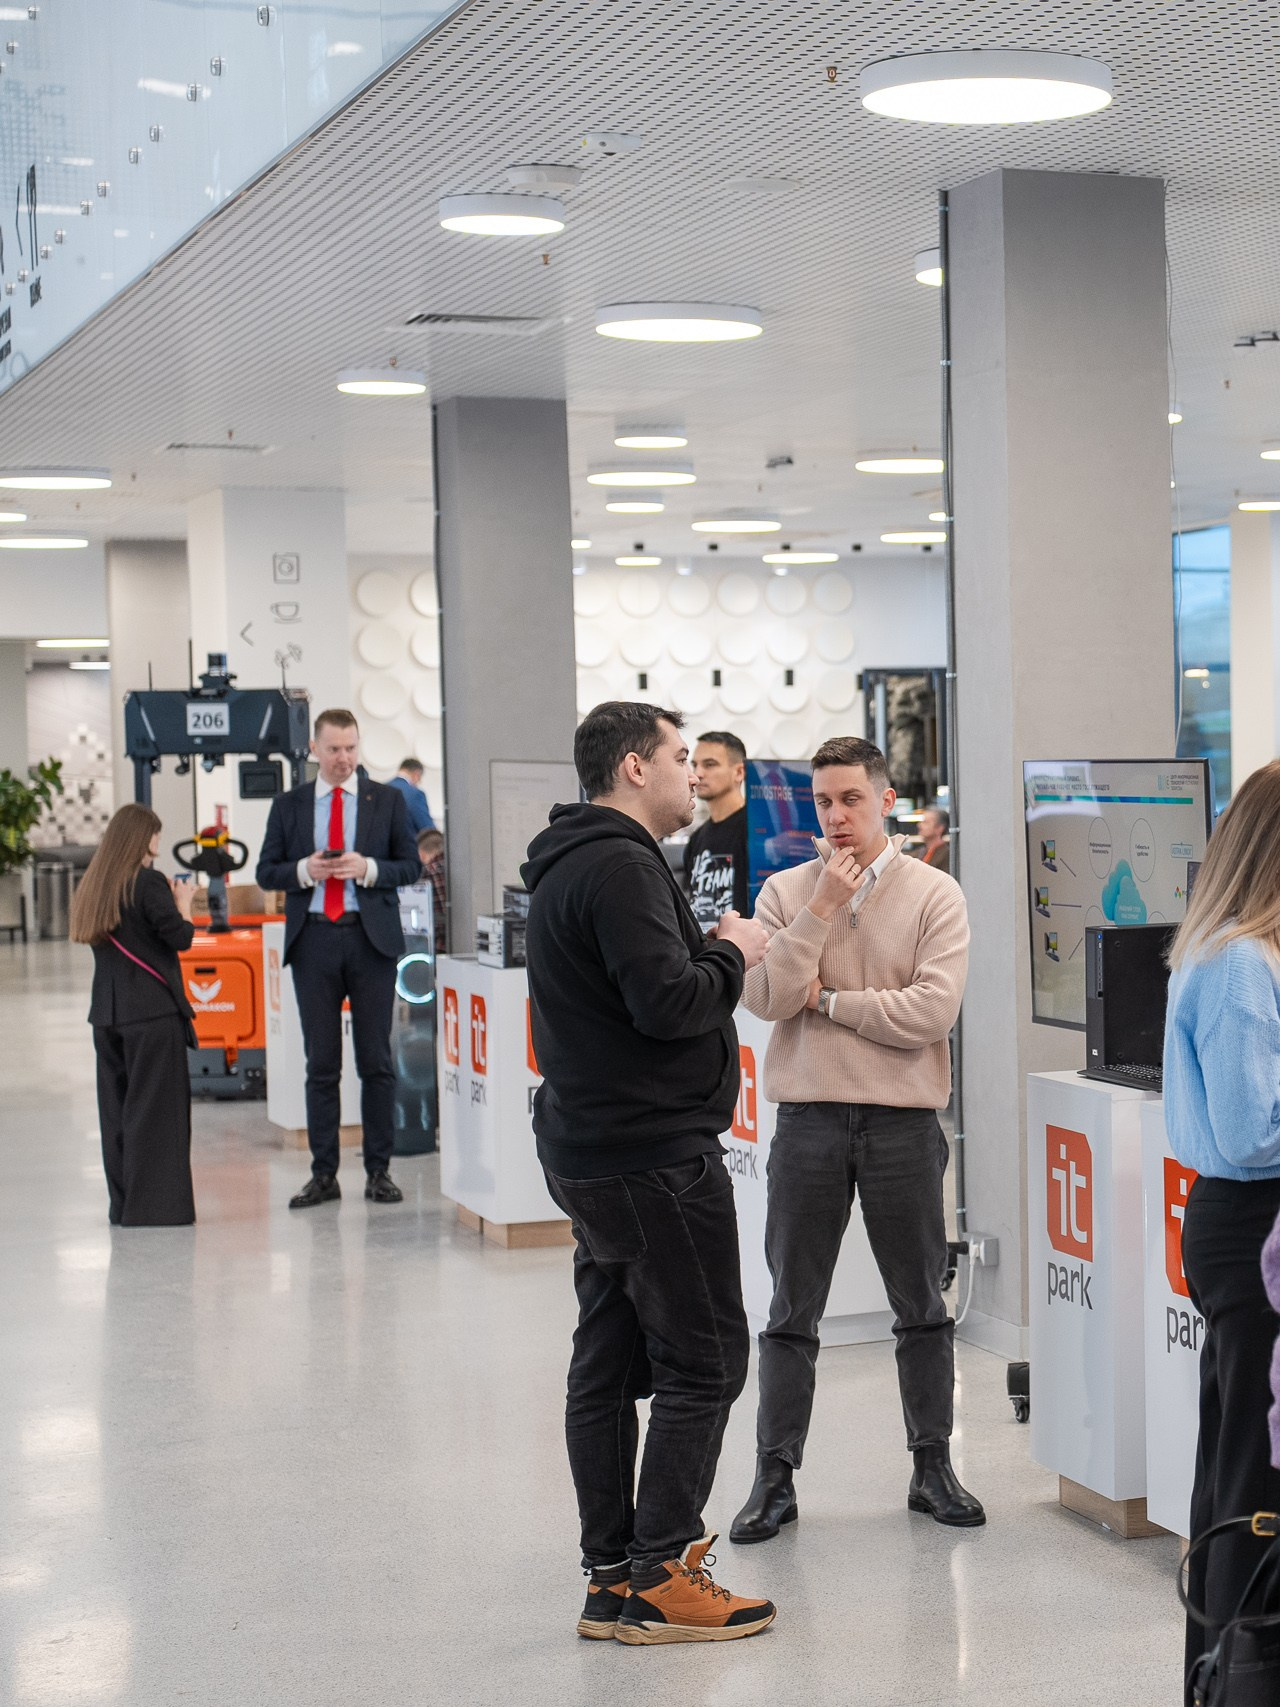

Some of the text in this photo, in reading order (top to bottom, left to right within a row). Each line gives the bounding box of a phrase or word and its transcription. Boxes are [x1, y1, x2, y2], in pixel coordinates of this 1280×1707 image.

[192, 712, 224, 729] 206
[445, 995, 458, 1056] it
[472, 1003, 485, 1066] it
[471, 1077, 488, 1108] park
[729, 1145, 758, 1180] park
[1052, 1143, 1088, 1244] it
[1047, 1261, 1093, 1310] park
[1166, 1306, 1205, 1353] par
